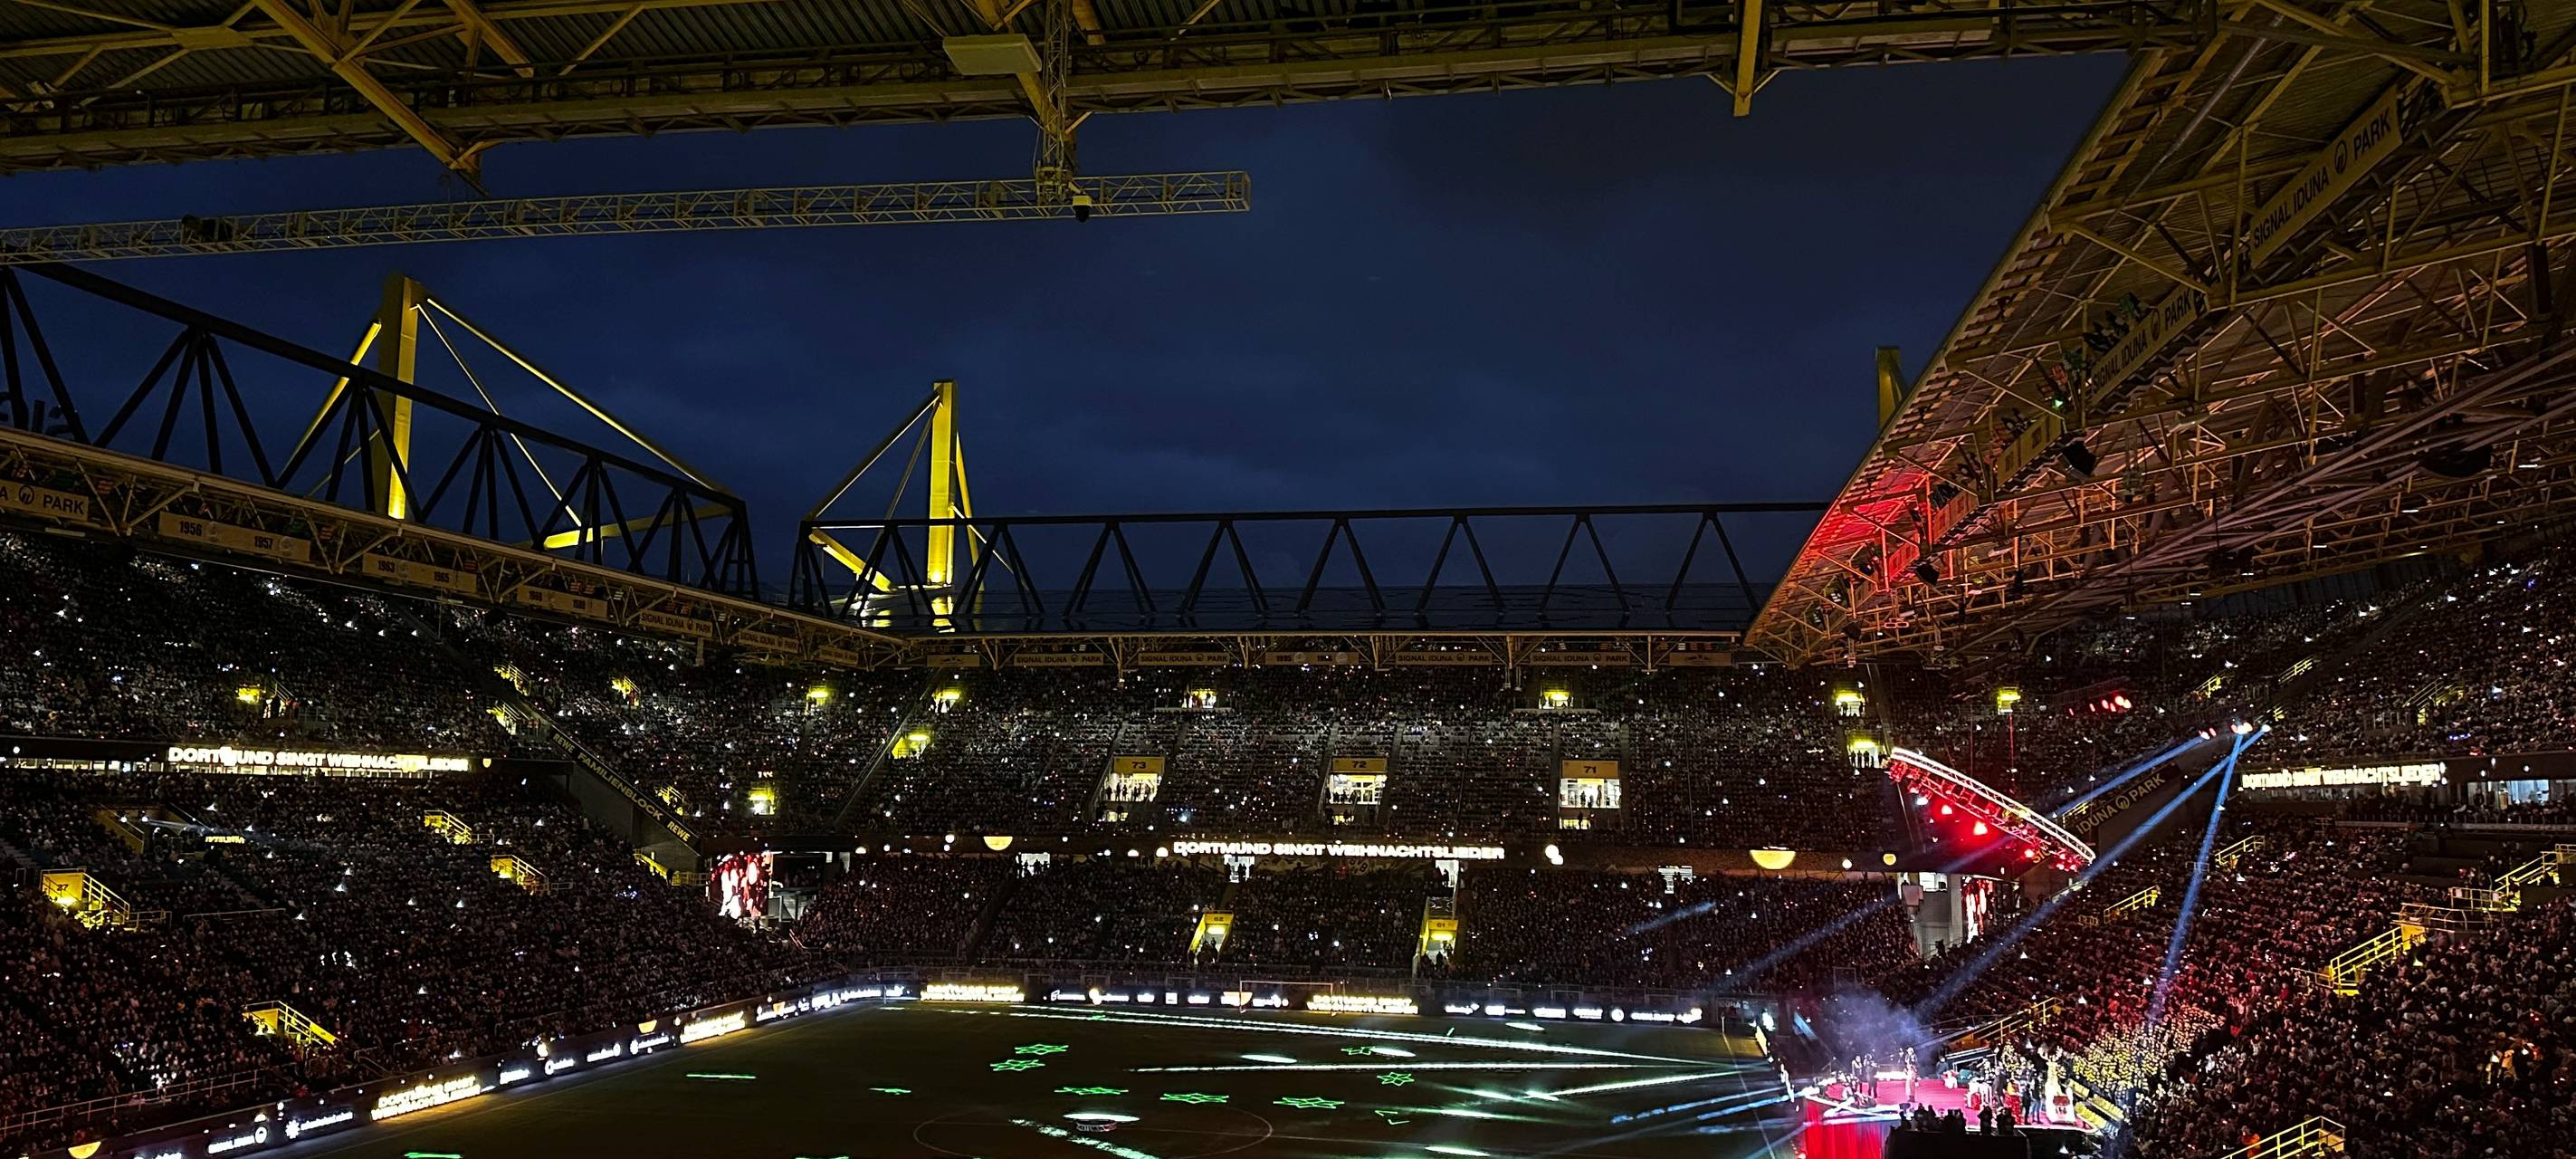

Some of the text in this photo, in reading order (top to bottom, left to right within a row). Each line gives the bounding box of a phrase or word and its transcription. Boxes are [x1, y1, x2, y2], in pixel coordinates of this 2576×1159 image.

[2253, 109, 2391, 248] SIGNAL IDUNA PARK
[2122, 330, 2148, 369] IDUNA
[2165, 288, 2191, 331] PARK
[43, 493, 84, 515] PARK
[179, 521, 203, 536] 1956
[276, 752, 326, 766] SINGT
[327, 753, 468, 771] WEIHNACLIEDER
[1352, 761, 1367, 769] 72
[553, 733, 691, 842] REWE FAMILIENBLOCK REWE
[2075, 805, 2118, 834] IDUNA
[2128, 773, 2165, 801] PARK
[1174, 842, 1504, 858] DORTMUND SINGT WEIHNACHTSLIEDER
